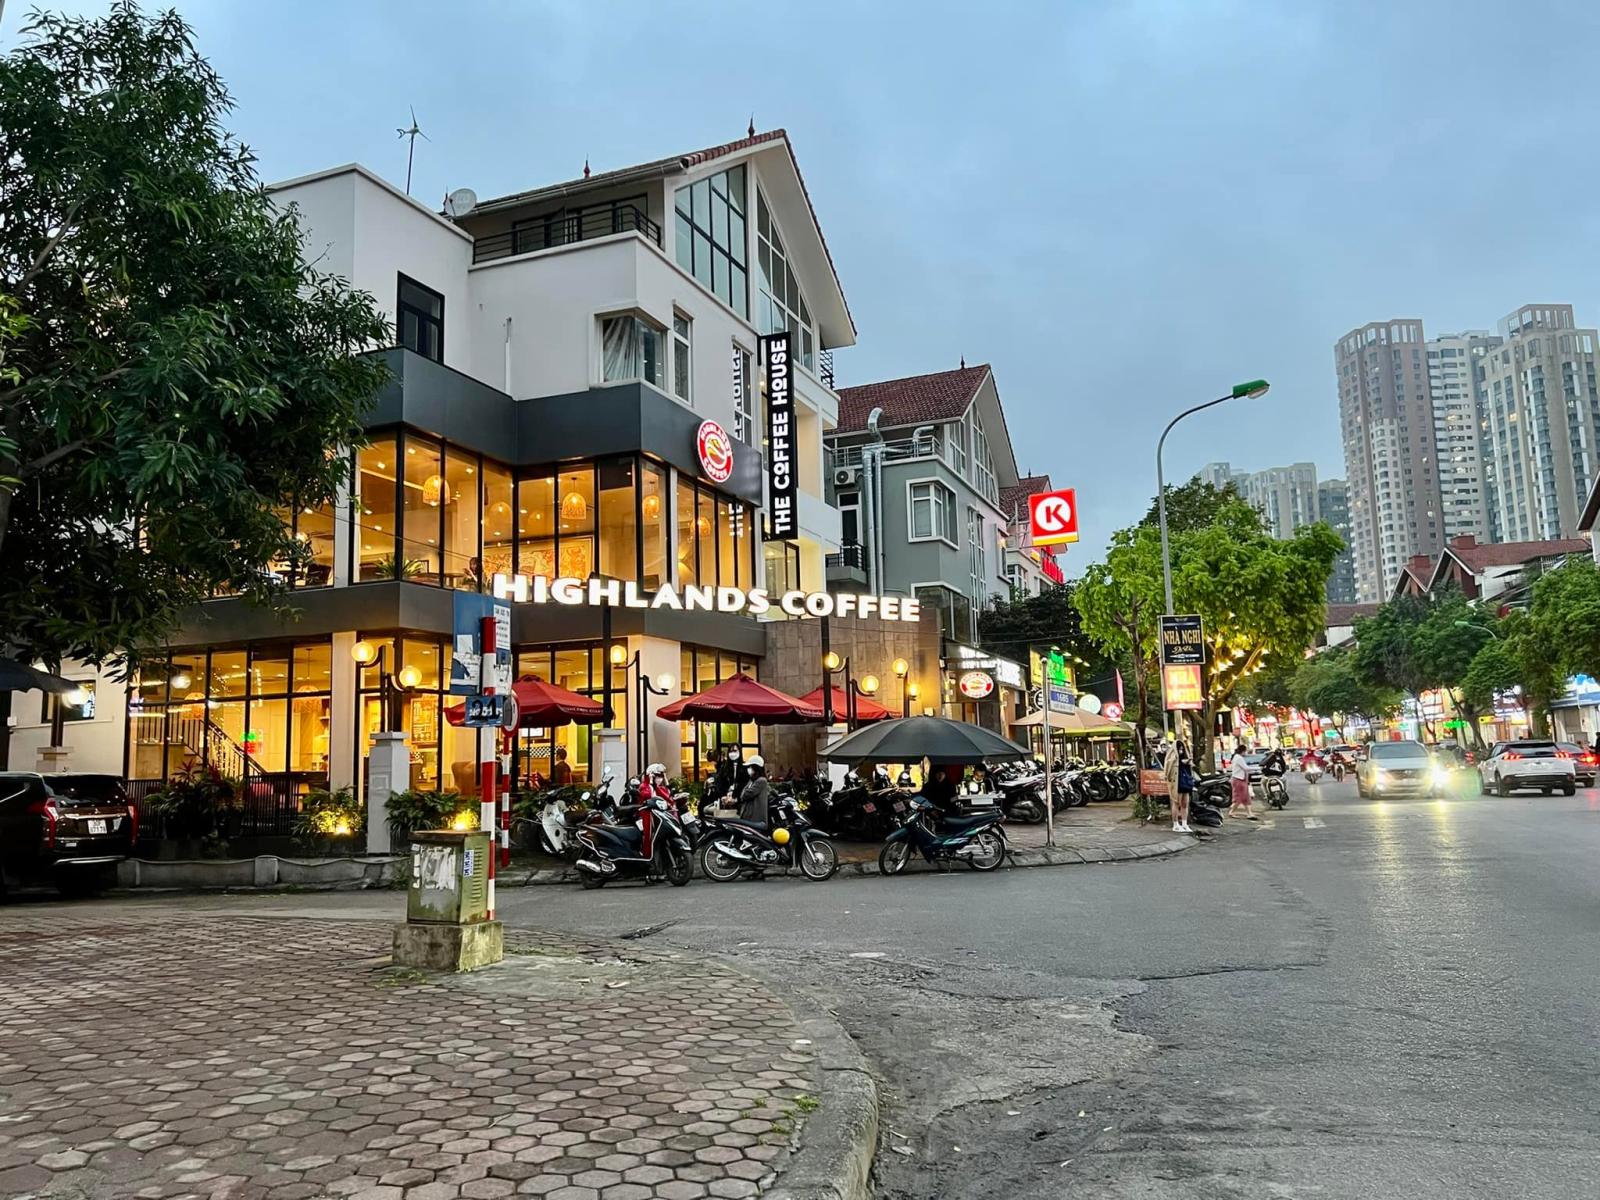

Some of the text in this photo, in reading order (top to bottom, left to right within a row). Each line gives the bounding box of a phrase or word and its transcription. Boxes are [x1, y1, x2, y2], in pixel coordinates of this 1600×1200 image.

[771, 339, 791, 535] THE COFFEE HOUSE
[1045, 504, 1069, 528] K
[493, 573, 920, 622] HIGHLANDS COFFEE
[1164, 626, 1181, 645] NHÀ
